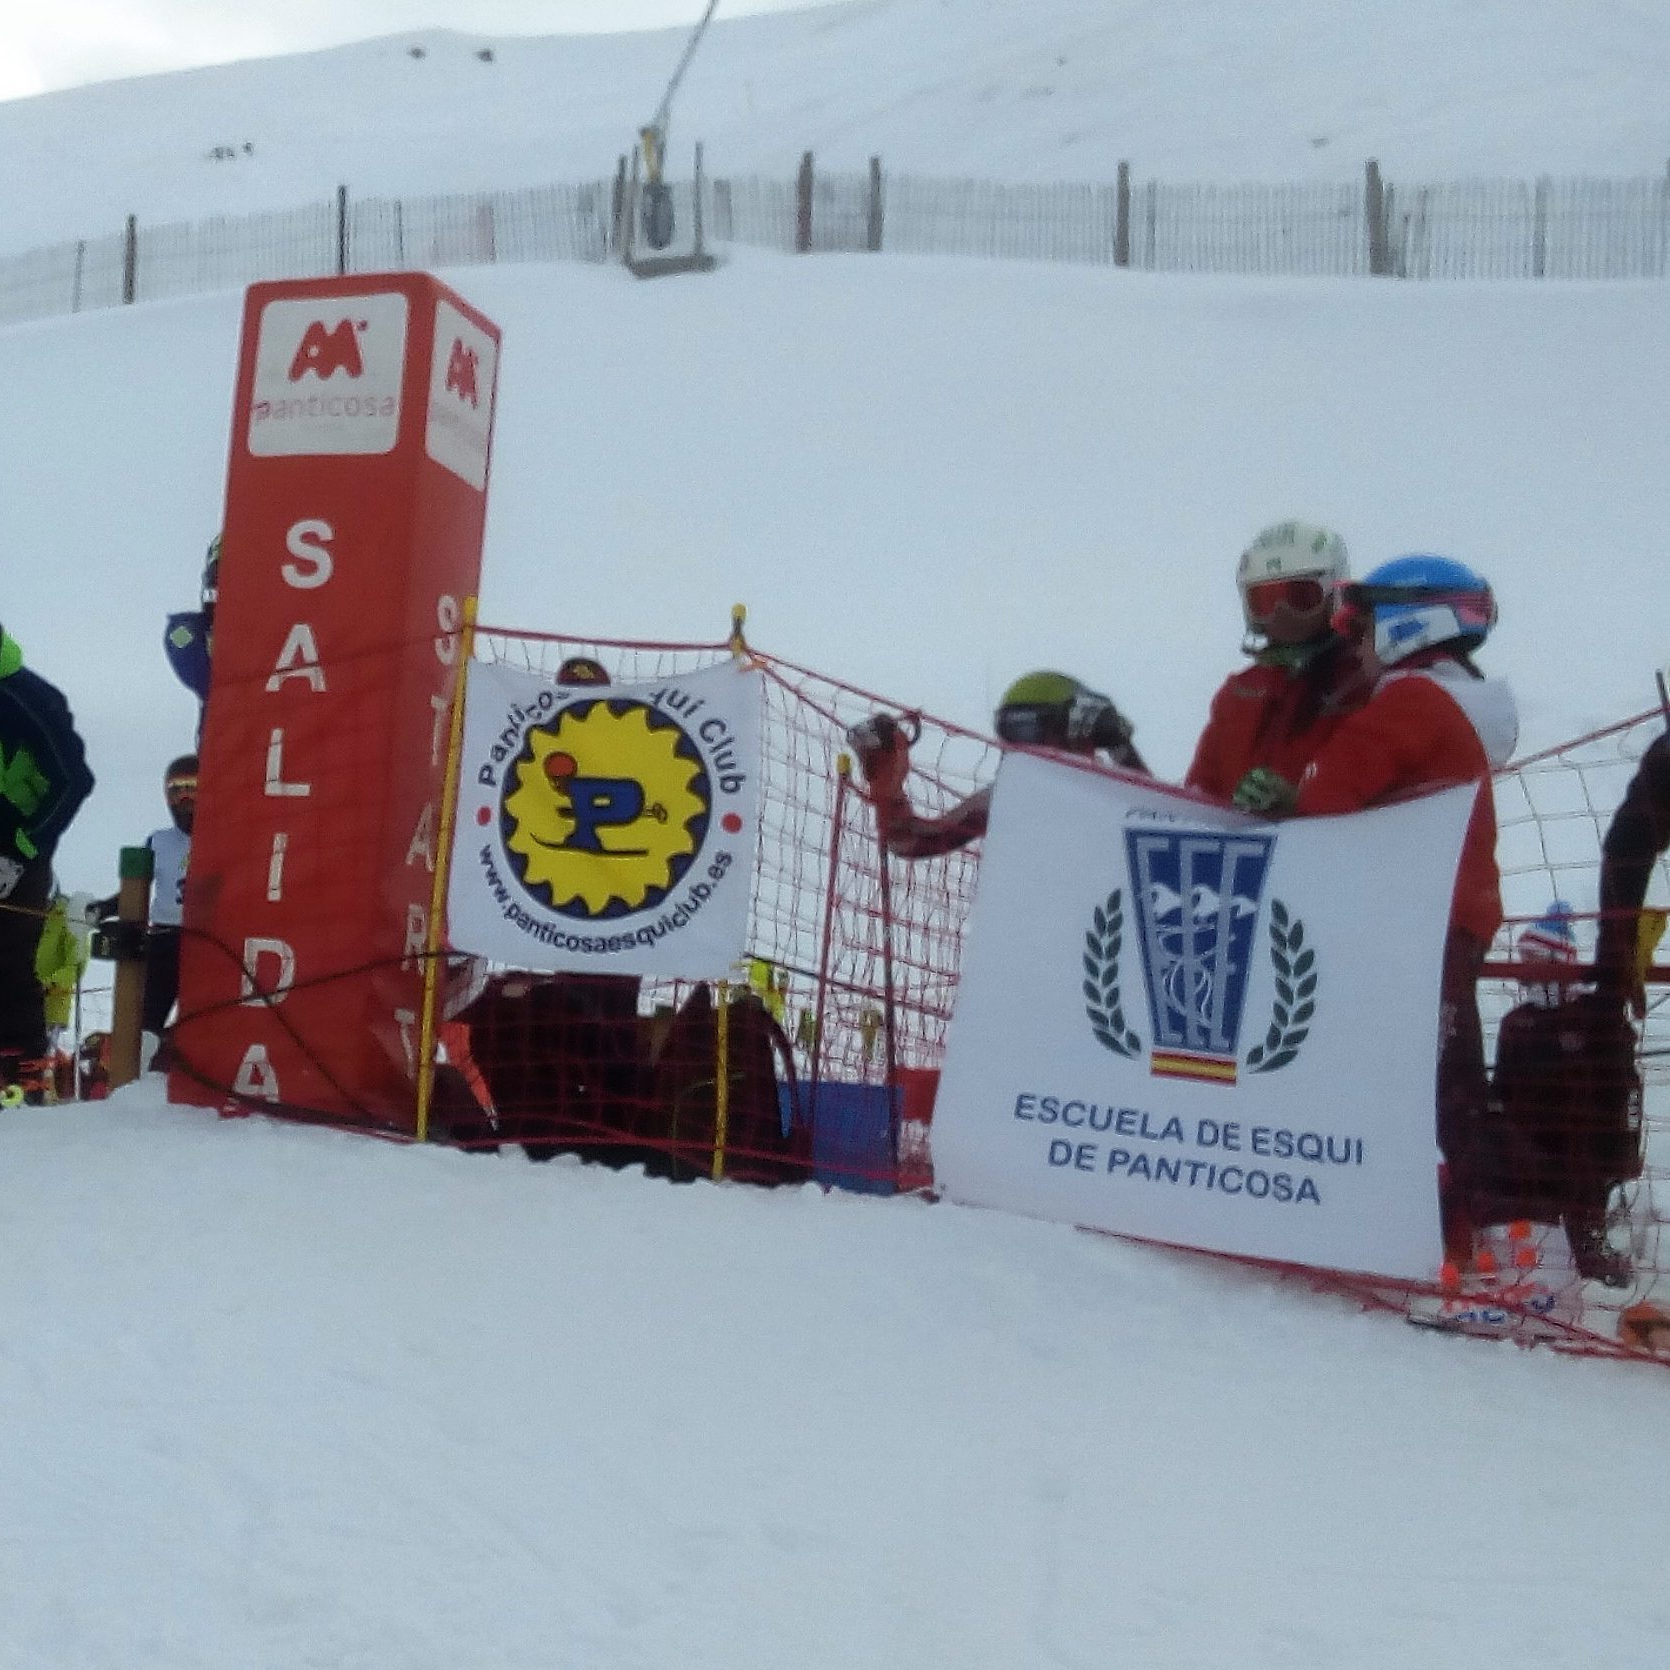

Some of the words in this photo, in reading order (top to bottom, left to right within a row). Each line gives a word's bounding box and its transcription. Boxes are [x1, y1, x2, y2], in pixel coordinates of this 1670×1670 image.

[698, 719, 747, 795] Club
[232, 518, 335, 1104] SALIDA
[1013, 1093, 1184, 1144] ESCUELA
[1196, 1118, 1242, 1151] DE
[1250, 1126, 1365, 1168] ESQUI
[1047, 1138, 1097, 1172] DE
[1106, 1147, 1323, 1207] PANTICOSA
